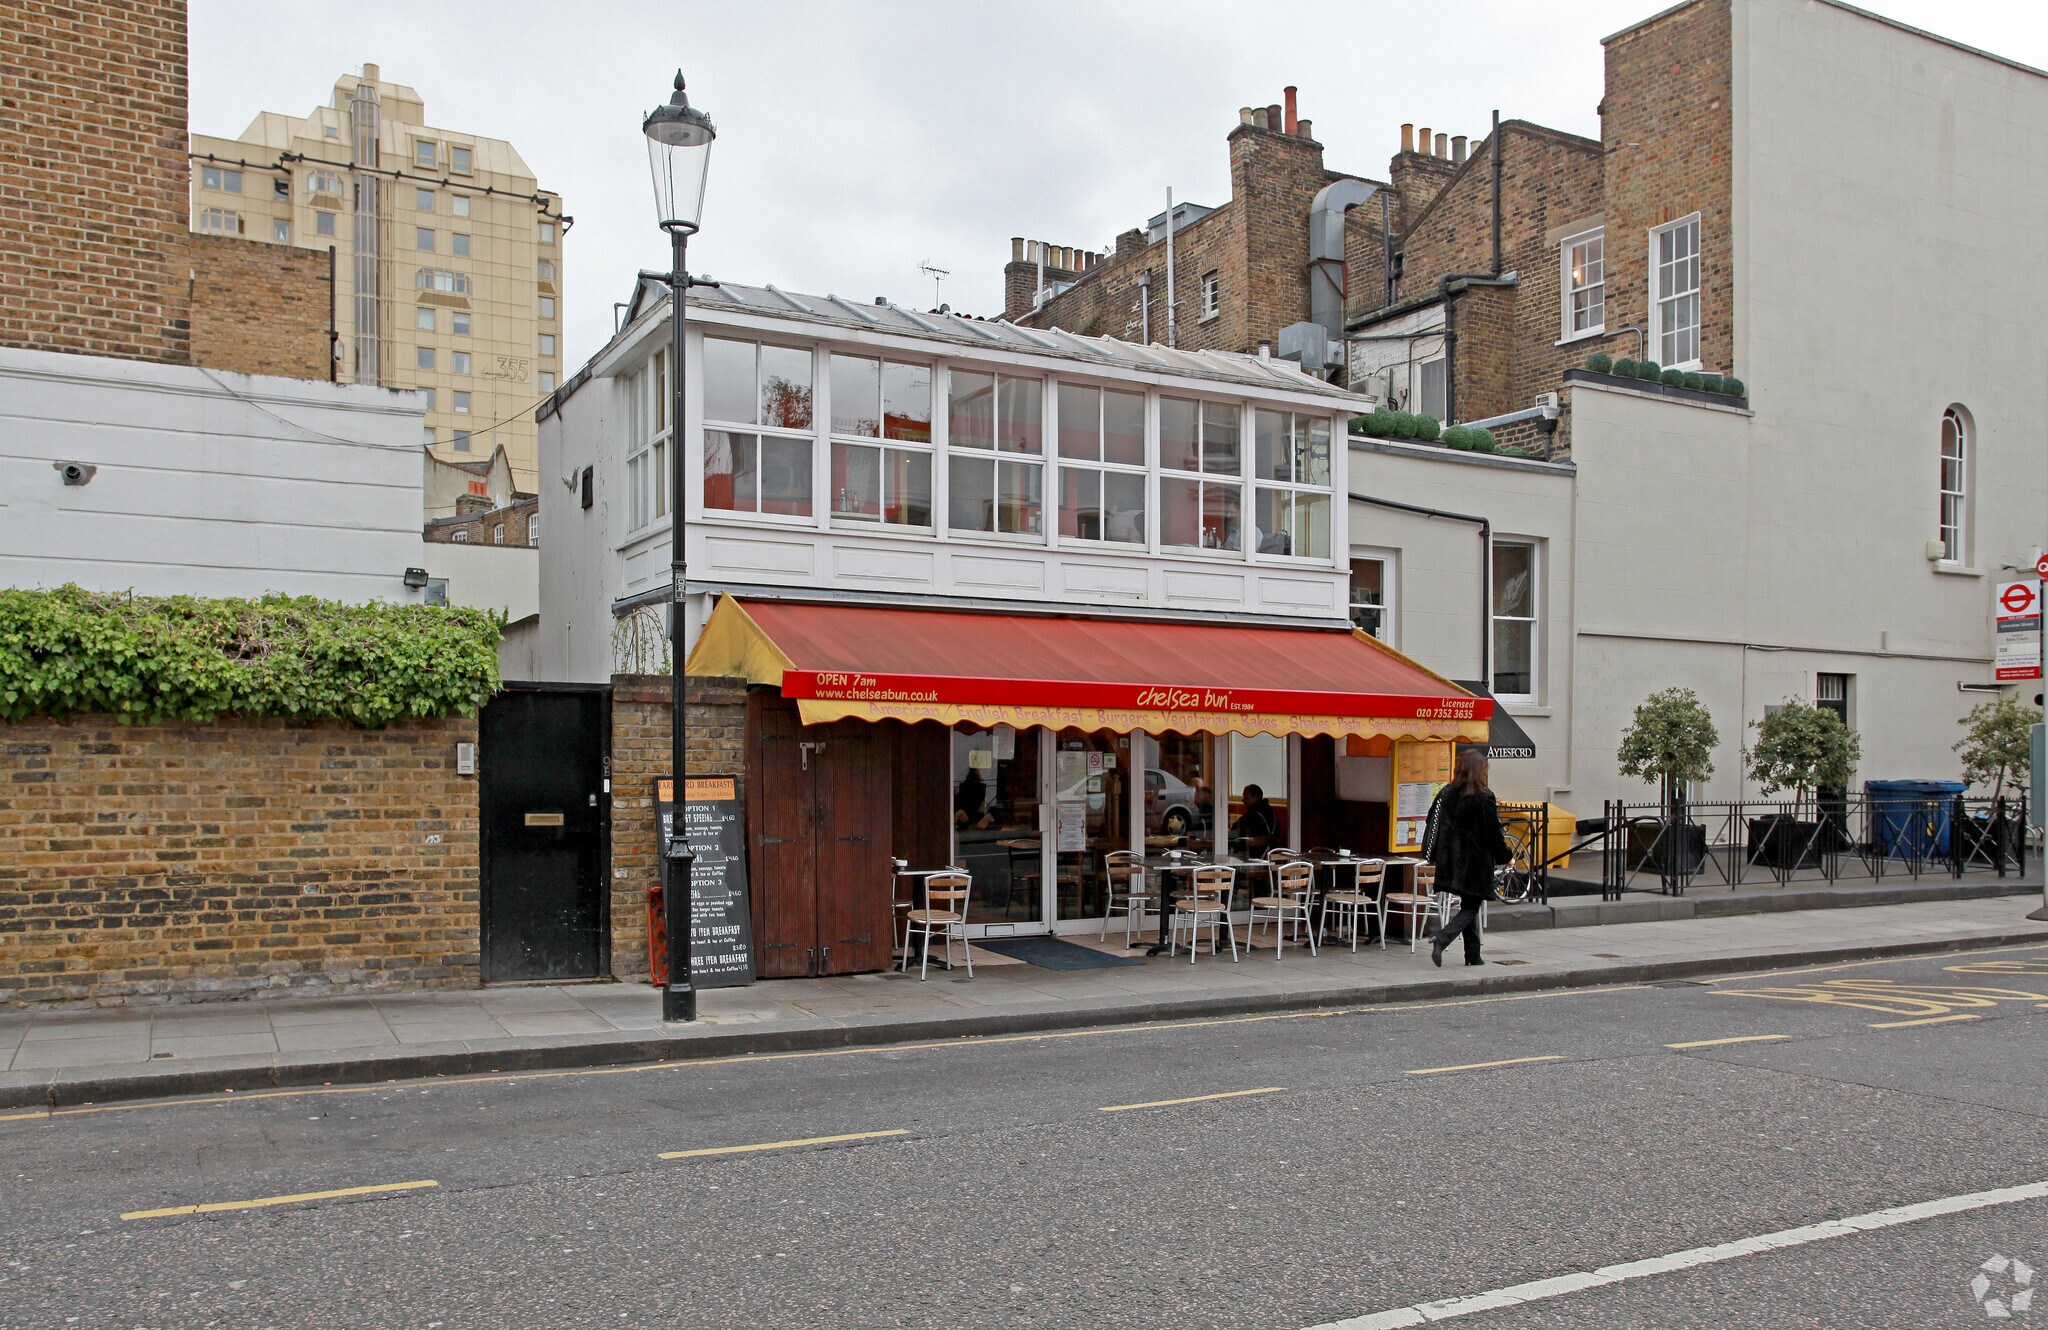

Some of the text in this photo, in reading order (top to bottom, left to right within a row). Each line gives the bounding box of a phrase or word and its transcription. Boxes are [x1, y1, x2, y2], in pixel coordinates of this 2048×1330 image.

[497, 357, 529, 381] 355
[817, 673, 876, 686] OPEN 7am
[816, 687, 938, 701] www.chelseabun.co.uk
[1441, 699, 1475, 709] Licensed
[869, 701, 940, 716] American
[955, 704, 1010, 721] English
[1014, 706, 1083, 722] Breakfast
[1096, 709, 1149, 728] Burgers
[1161, 710, 1229, 729] Vegetarian
[1241, 714, 1277, 728] Bakes
[1289, 715, 1330, 729] Shakes
[1337, 716, 1360, 729] Pasta
[1368, 717, 1420, 733] Sandwiches
[1426, 719, 1459, 733] Seafood
[1416, 709, 1473, 719] 020 7352 3635
[1487, 746, 1533, 758] AYLESFORD
[697, 780, 733, 788] BREAKFASTS
[691, 956, 704, 967] HREE
